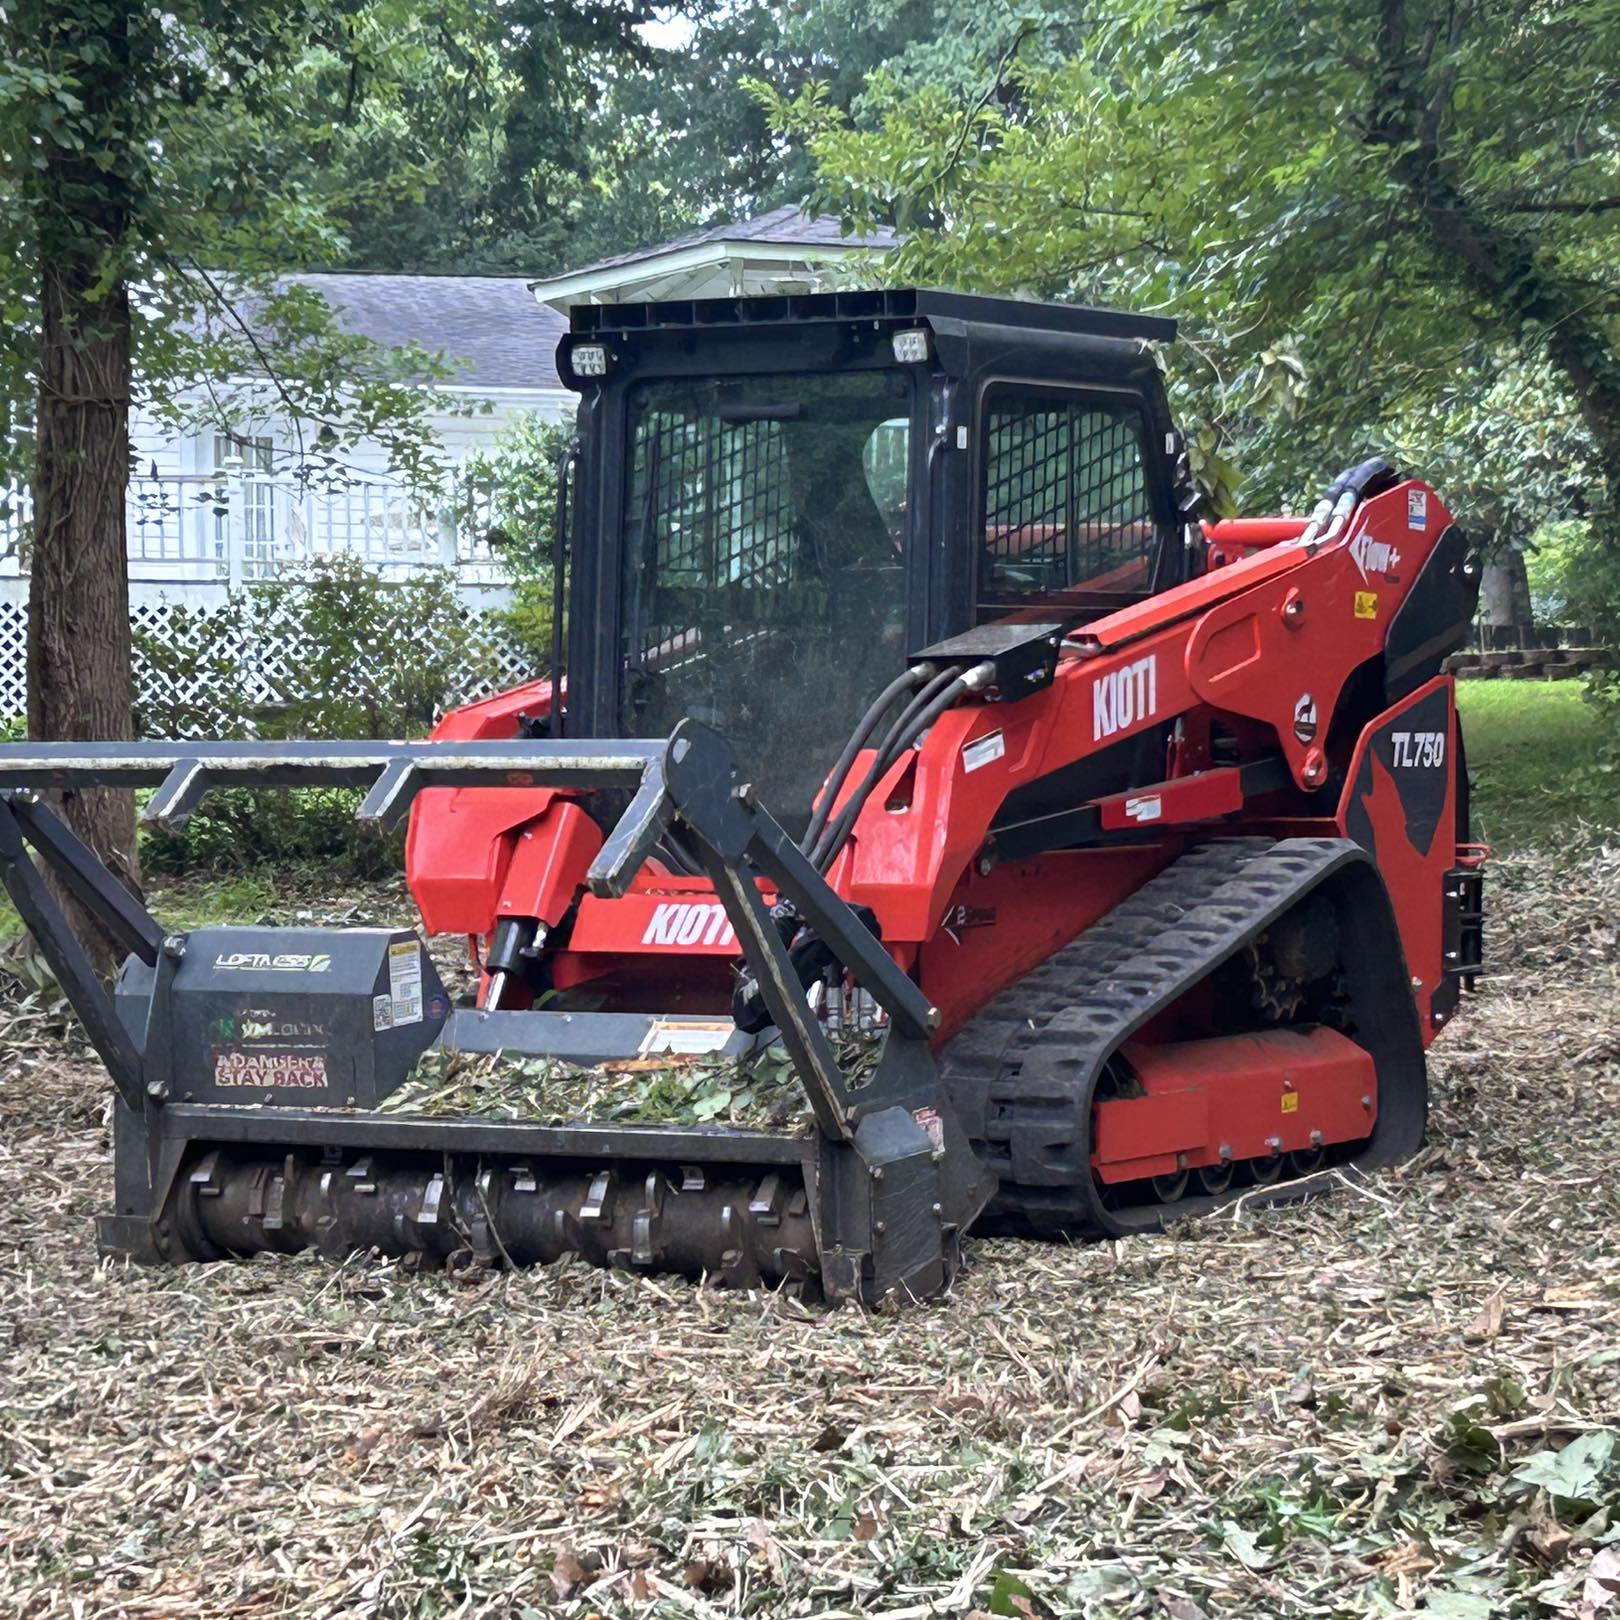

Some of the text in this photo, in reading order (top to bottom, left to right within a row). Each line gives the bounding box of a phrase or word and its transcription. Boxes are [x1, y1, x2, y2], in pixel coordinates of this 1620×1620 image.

[1092, 654, 1157, 742] KIOTI
[1391, 731, 1445, 768] TL750
[216, 1067, 267, 1086] STAY
